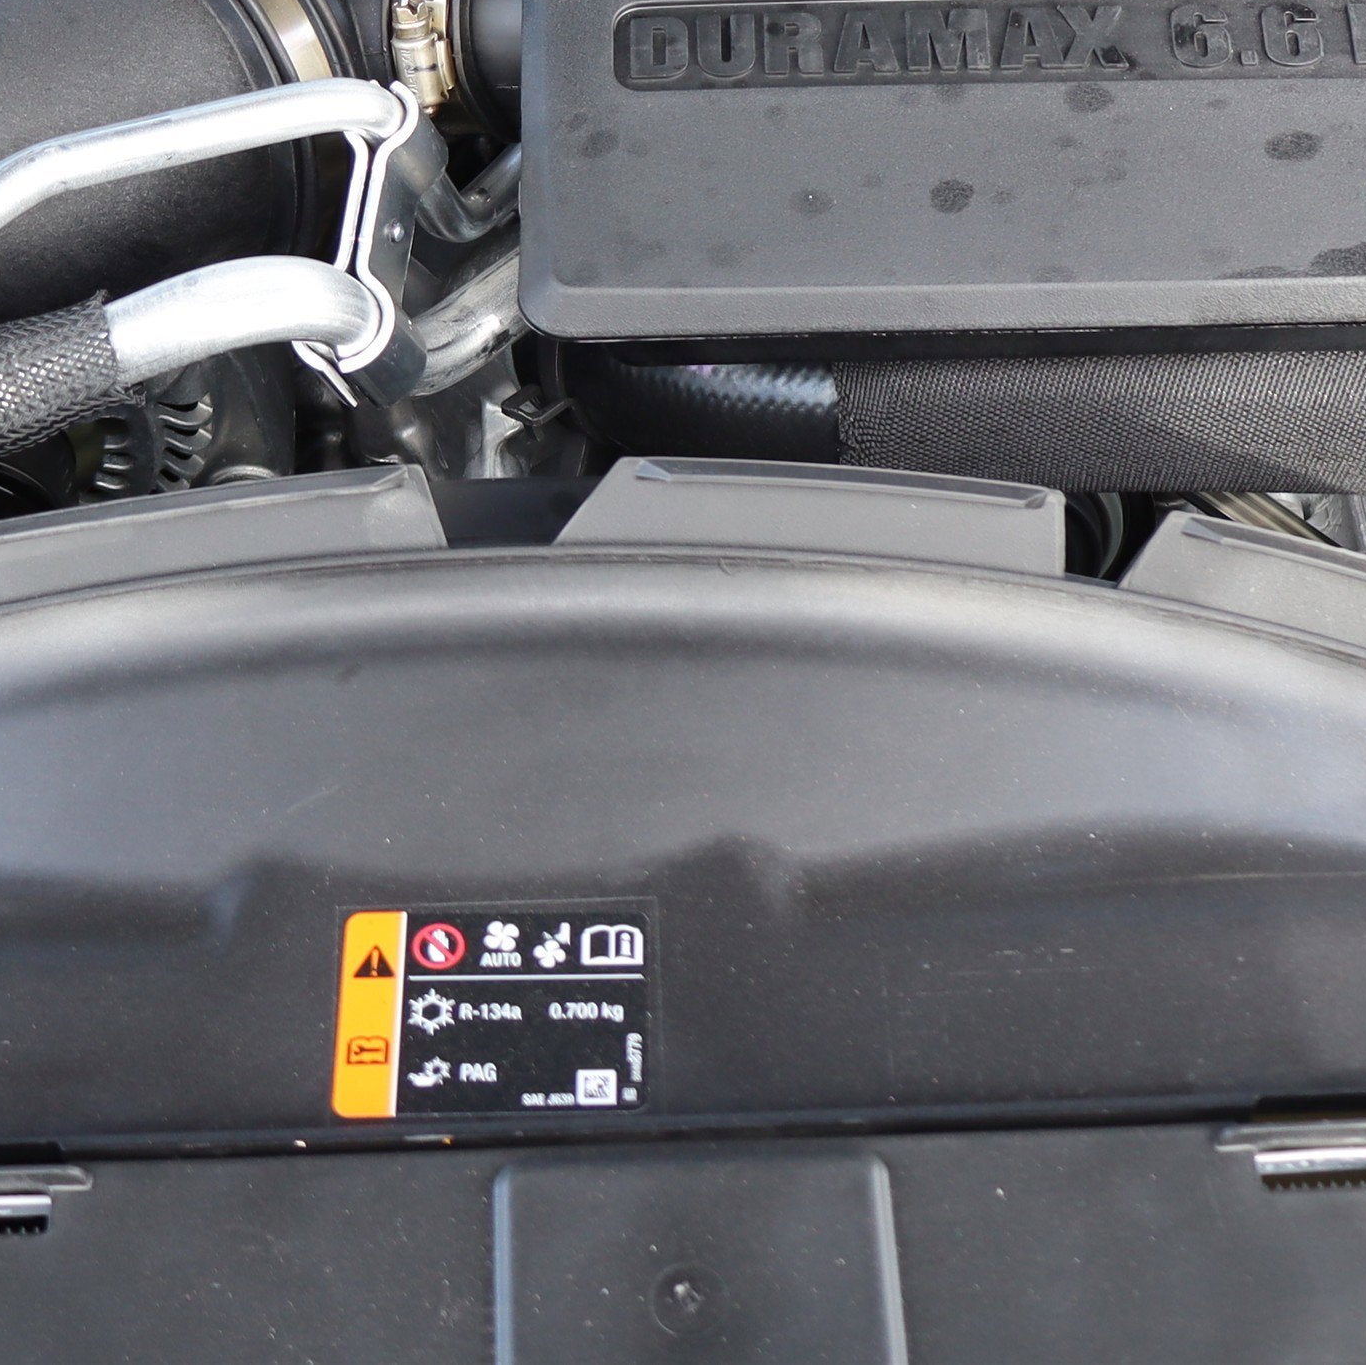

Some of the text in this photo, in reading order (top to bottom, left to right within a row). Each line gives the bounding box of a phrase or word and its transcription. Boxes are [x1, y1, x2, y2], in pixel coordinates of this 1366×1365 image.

[638, 5, 1132, 80] DURAMAX
[1169, 3, 1325, 70] 6.6
[479, 952, 522, 968] AUTO
[458, 1001, 625, 1023] R-134a 0.700 kg
[459, 1063, 499, 1083] PAG
